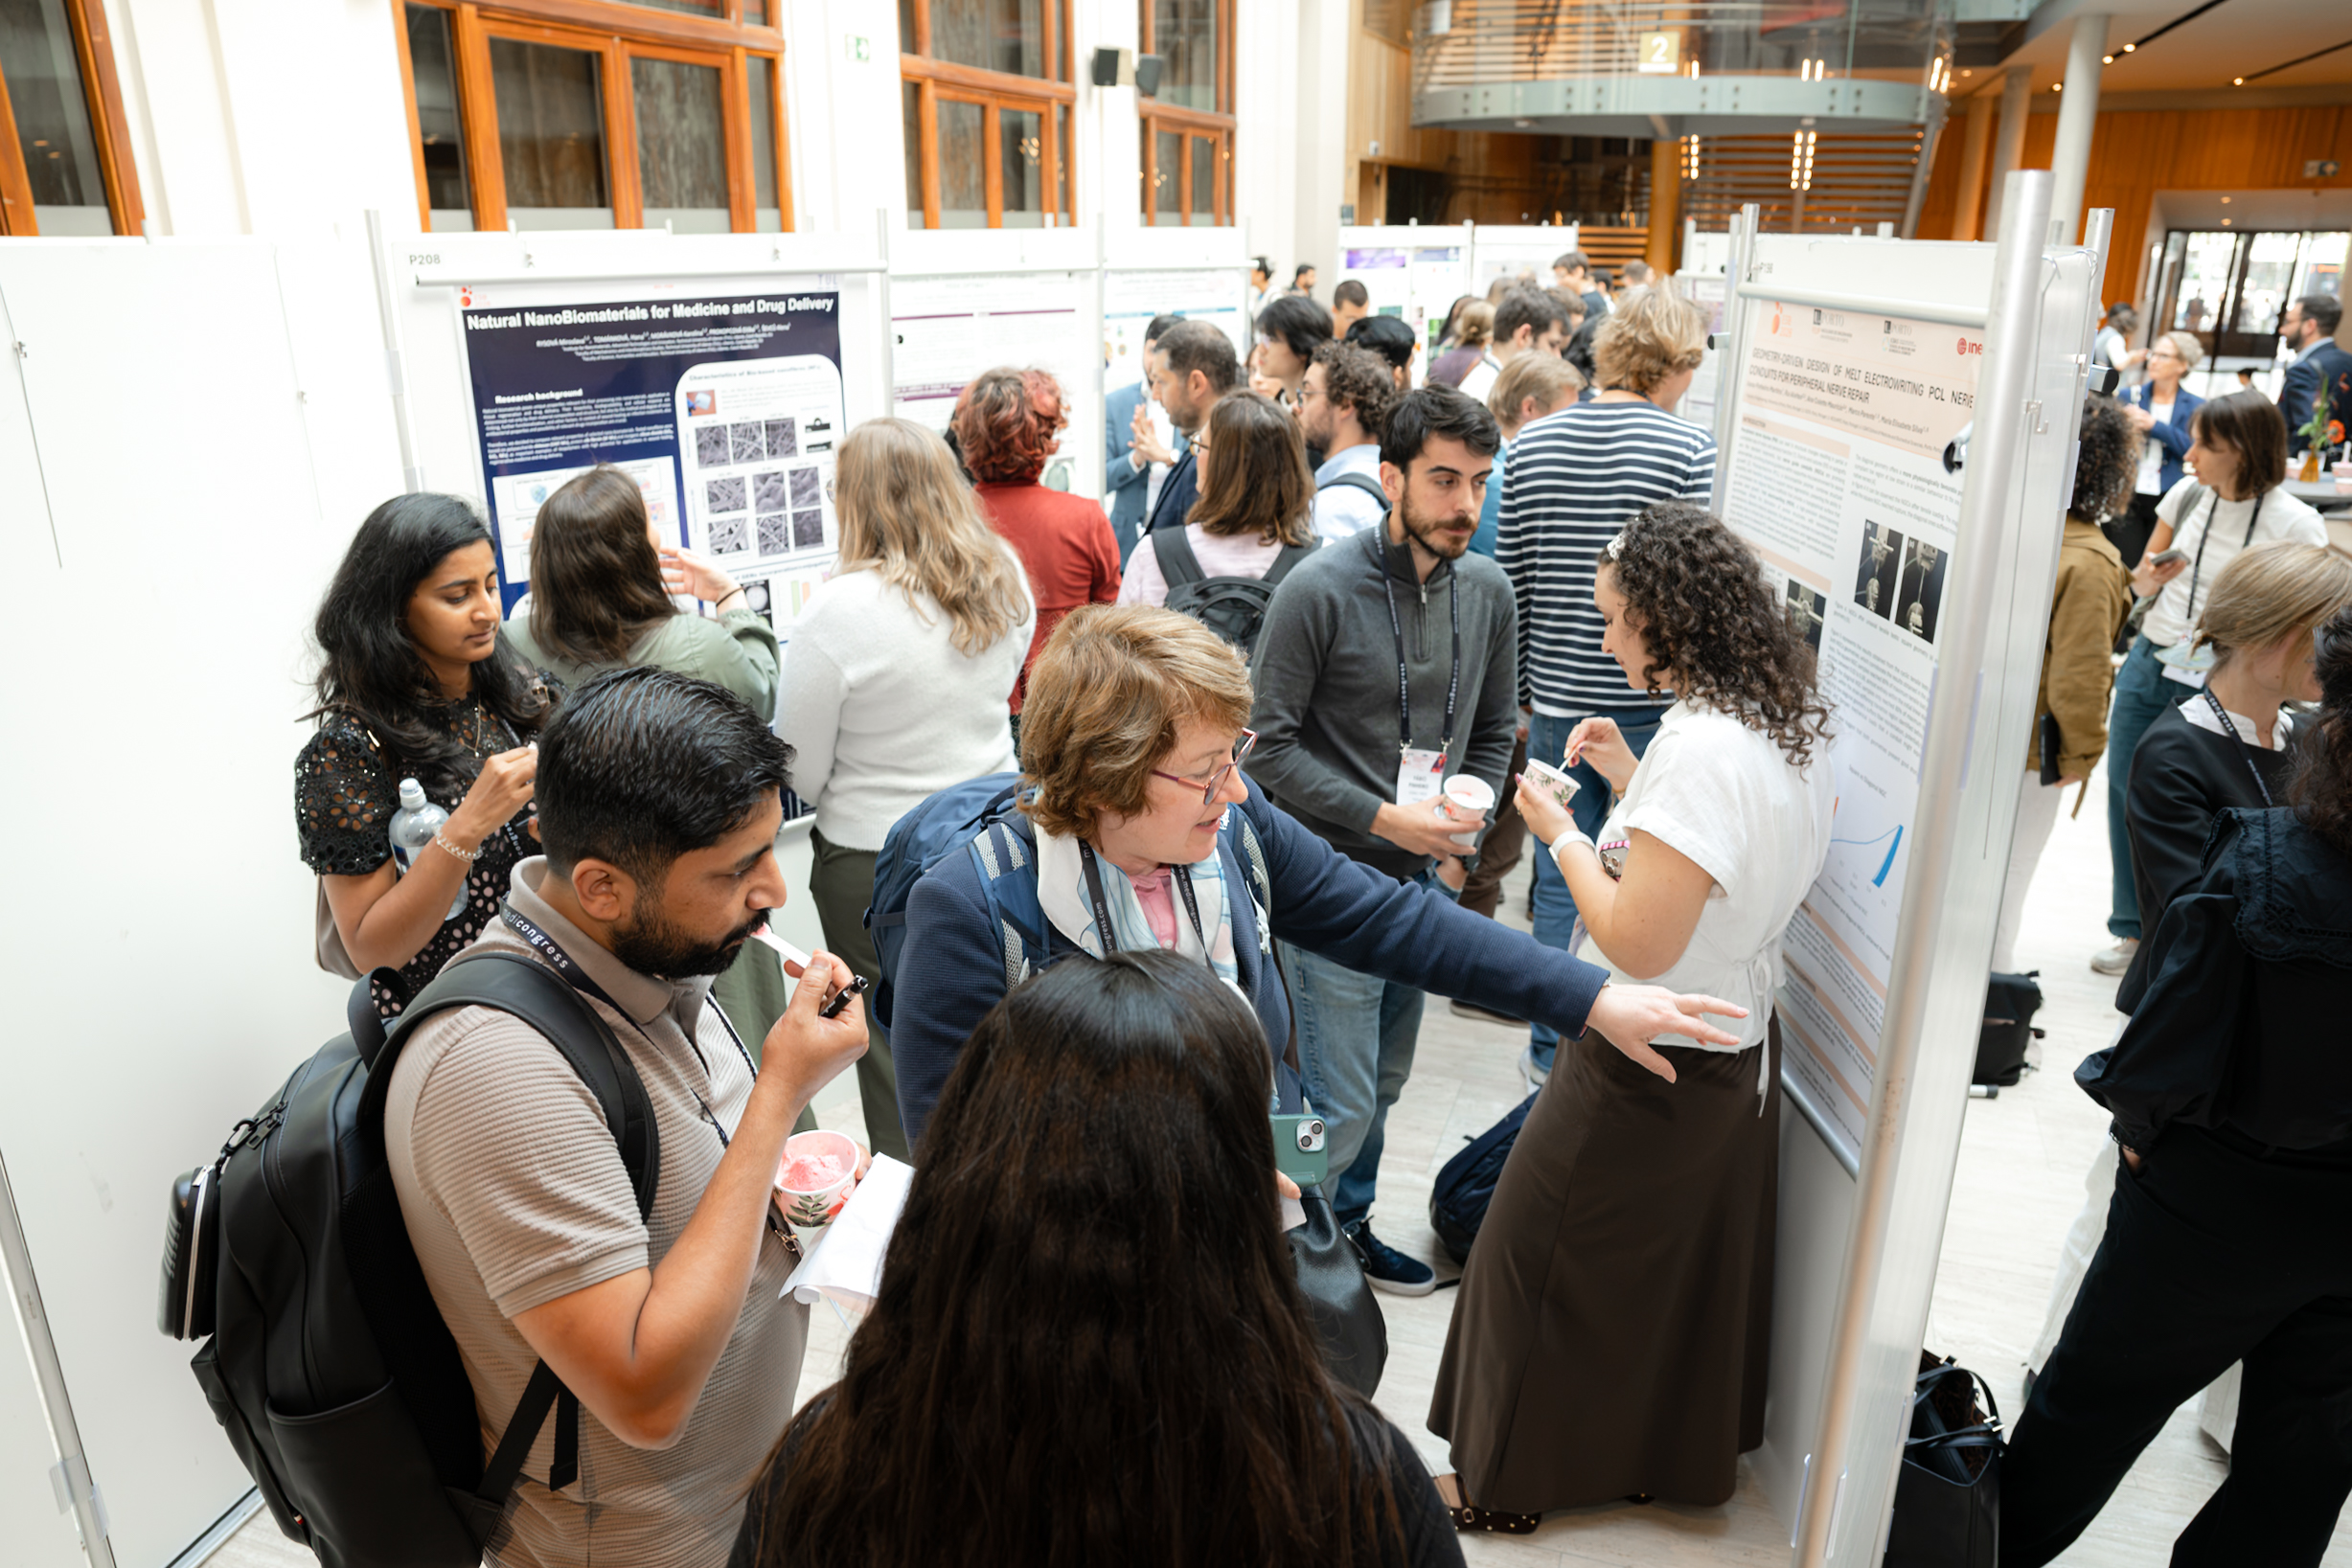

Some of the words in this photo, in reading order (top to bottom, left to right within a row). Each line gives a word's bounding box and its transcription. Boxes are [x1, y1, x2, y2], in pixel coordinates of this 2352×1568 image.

[1651, 35, 1668, 62] 2
[409, 254, 441, 265] P208
[467, 311, 522, 330] Natural
[524, 305, 650, 328] NanoBiomaterials
[651, 304, 671, 319] for
[672, 301, 730, 319] Medicine
[732, 299, 755, 315] and
[756, 298, 787, 315] Drug
[788, 297, 834, 312] Delivery
[1968, 342, 1983, 355] ine
[1748, 364, 1777, 381] CONDUITS
[1777, 371, 1790, 384] FOR
[1789, 372, 1826, 393] PERIPHERAL
[1826, 380, 1847, 398] NERVE
[1847, 385, 1870, 404] REPAIR
[1752, 347, 1804, 370] GEOMETRY-DRIVEN
[1806, 358, 1830, 375] DESIGN
[1833, 364, 1842, 377] OF
[1844, 366, 1861, 381] MELT
[1863, 371, 1924, 397] ELECTROWRITING
[1928, 385, 1946, 402] PCL
[1950, 390, 1975, 410] NERVE
[494, 392, 535, 404] Research
[535, 388, 584, 402] background
[2208, 696, 2234, 733] congress
[1096, 901, 1114, 954] congress.com
